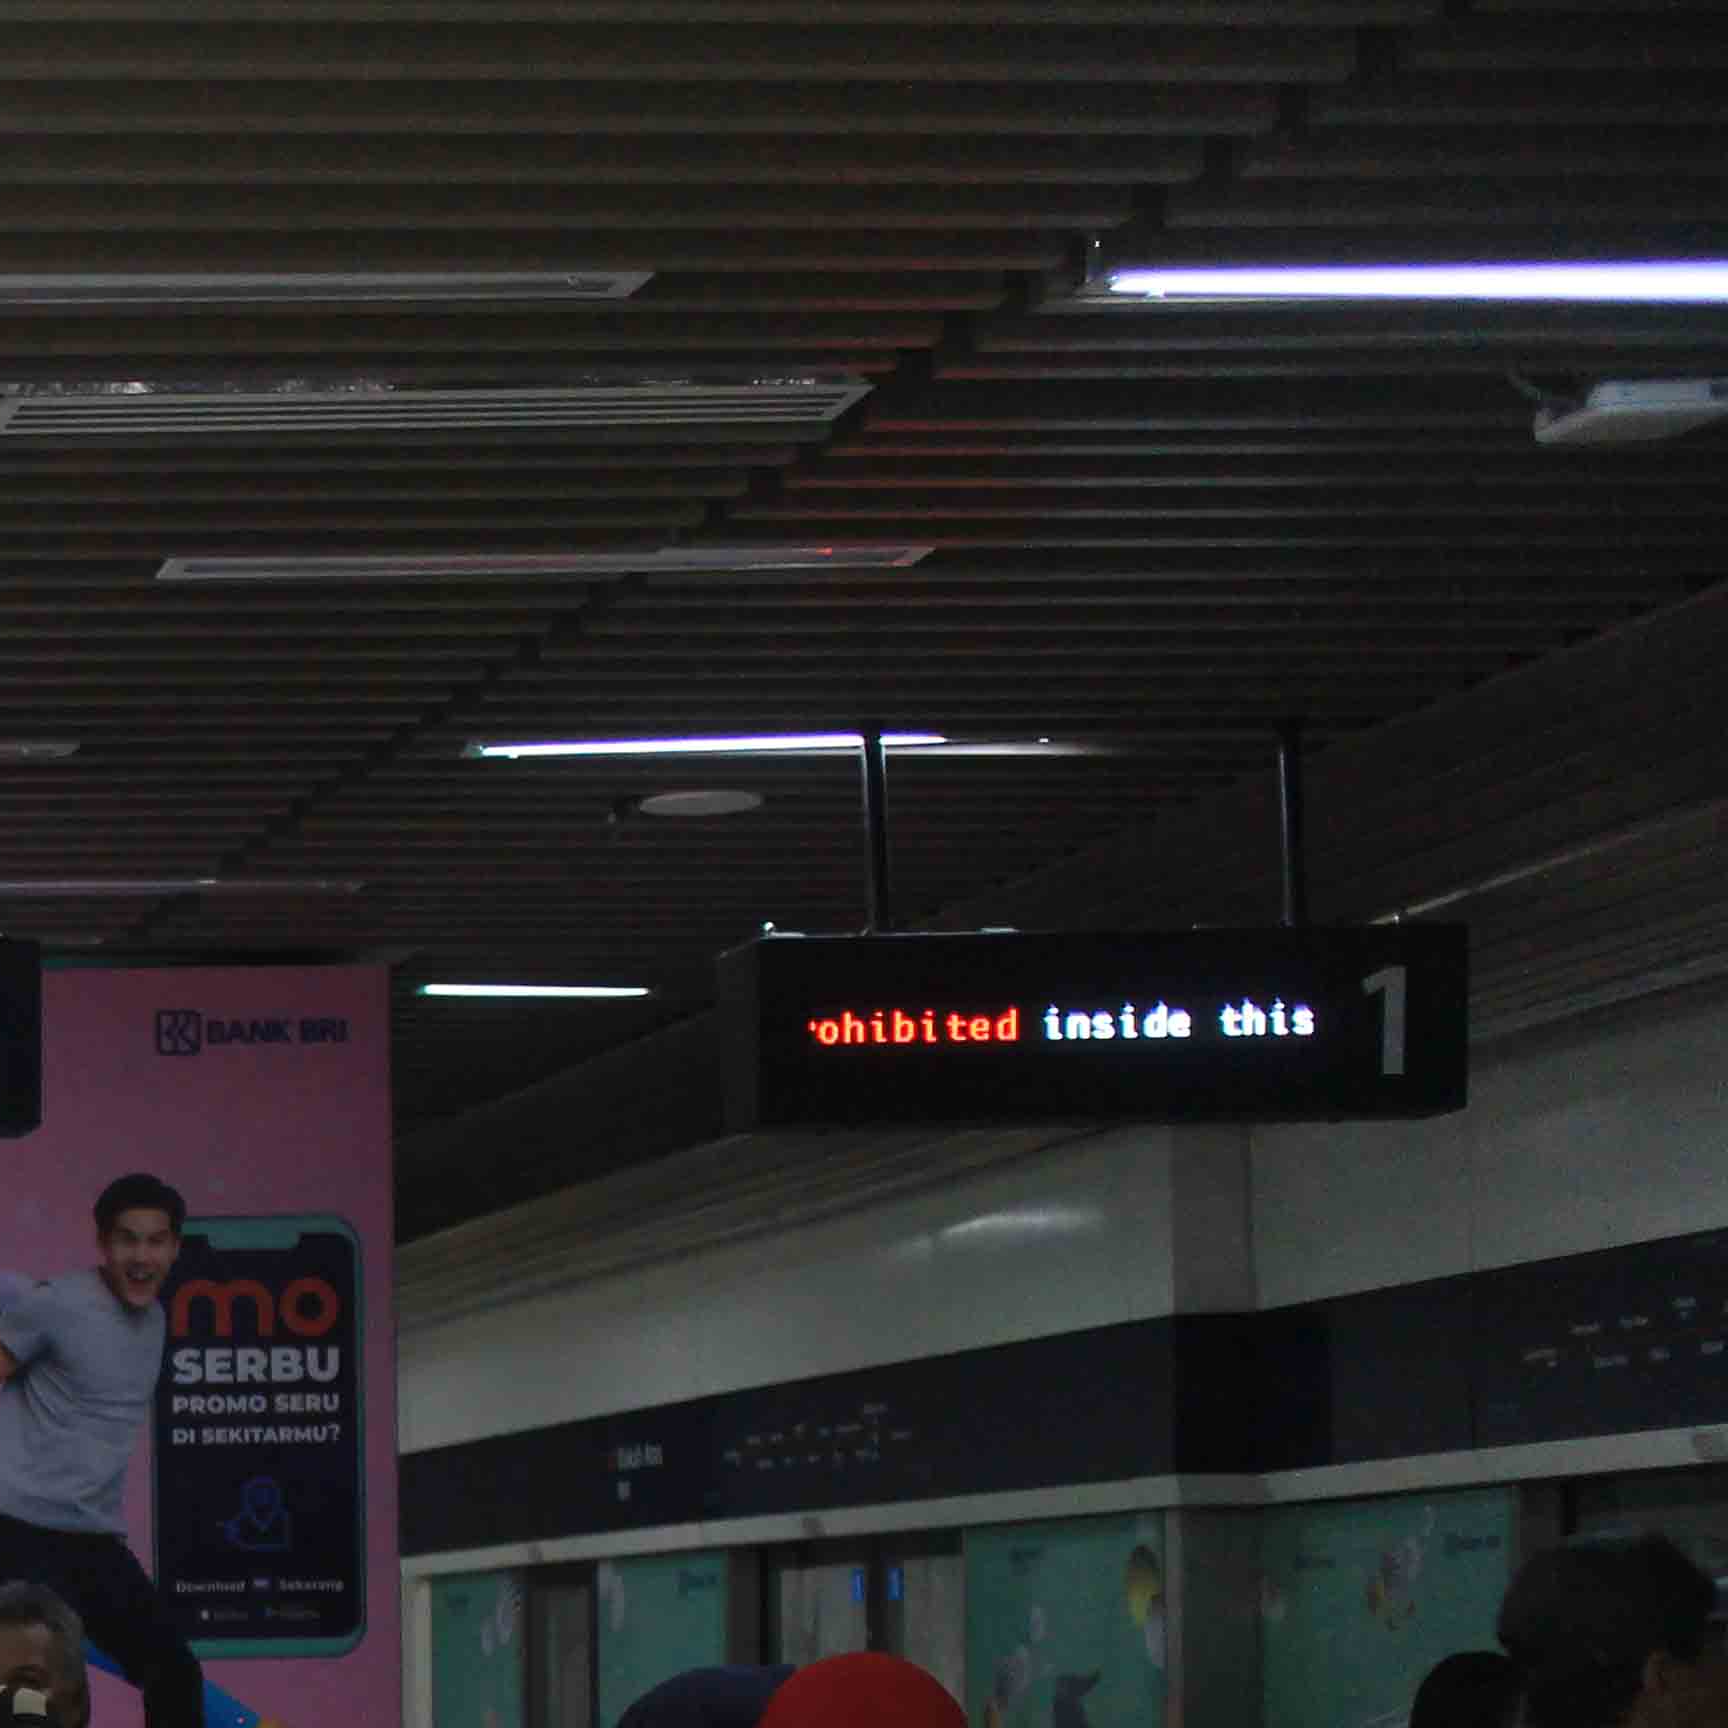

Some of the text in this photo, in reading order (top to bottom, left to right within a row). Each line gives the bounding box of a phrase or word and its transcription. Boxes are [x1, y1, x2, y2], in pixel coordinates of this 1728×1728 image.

[207, 1018, 347, 1044] BANK BRI
[809, 998, 1315, 1045] ohibited inside this
[1362, 965, 1406, 1075] 1
[173, 1276, 338, 1337] mo
[173, 1347, 340, 1384] SERBU
[173, 1393, 340, 1414] PROMO SERU
[173, 1424, 341, 1444] DI SEKITARMU?
